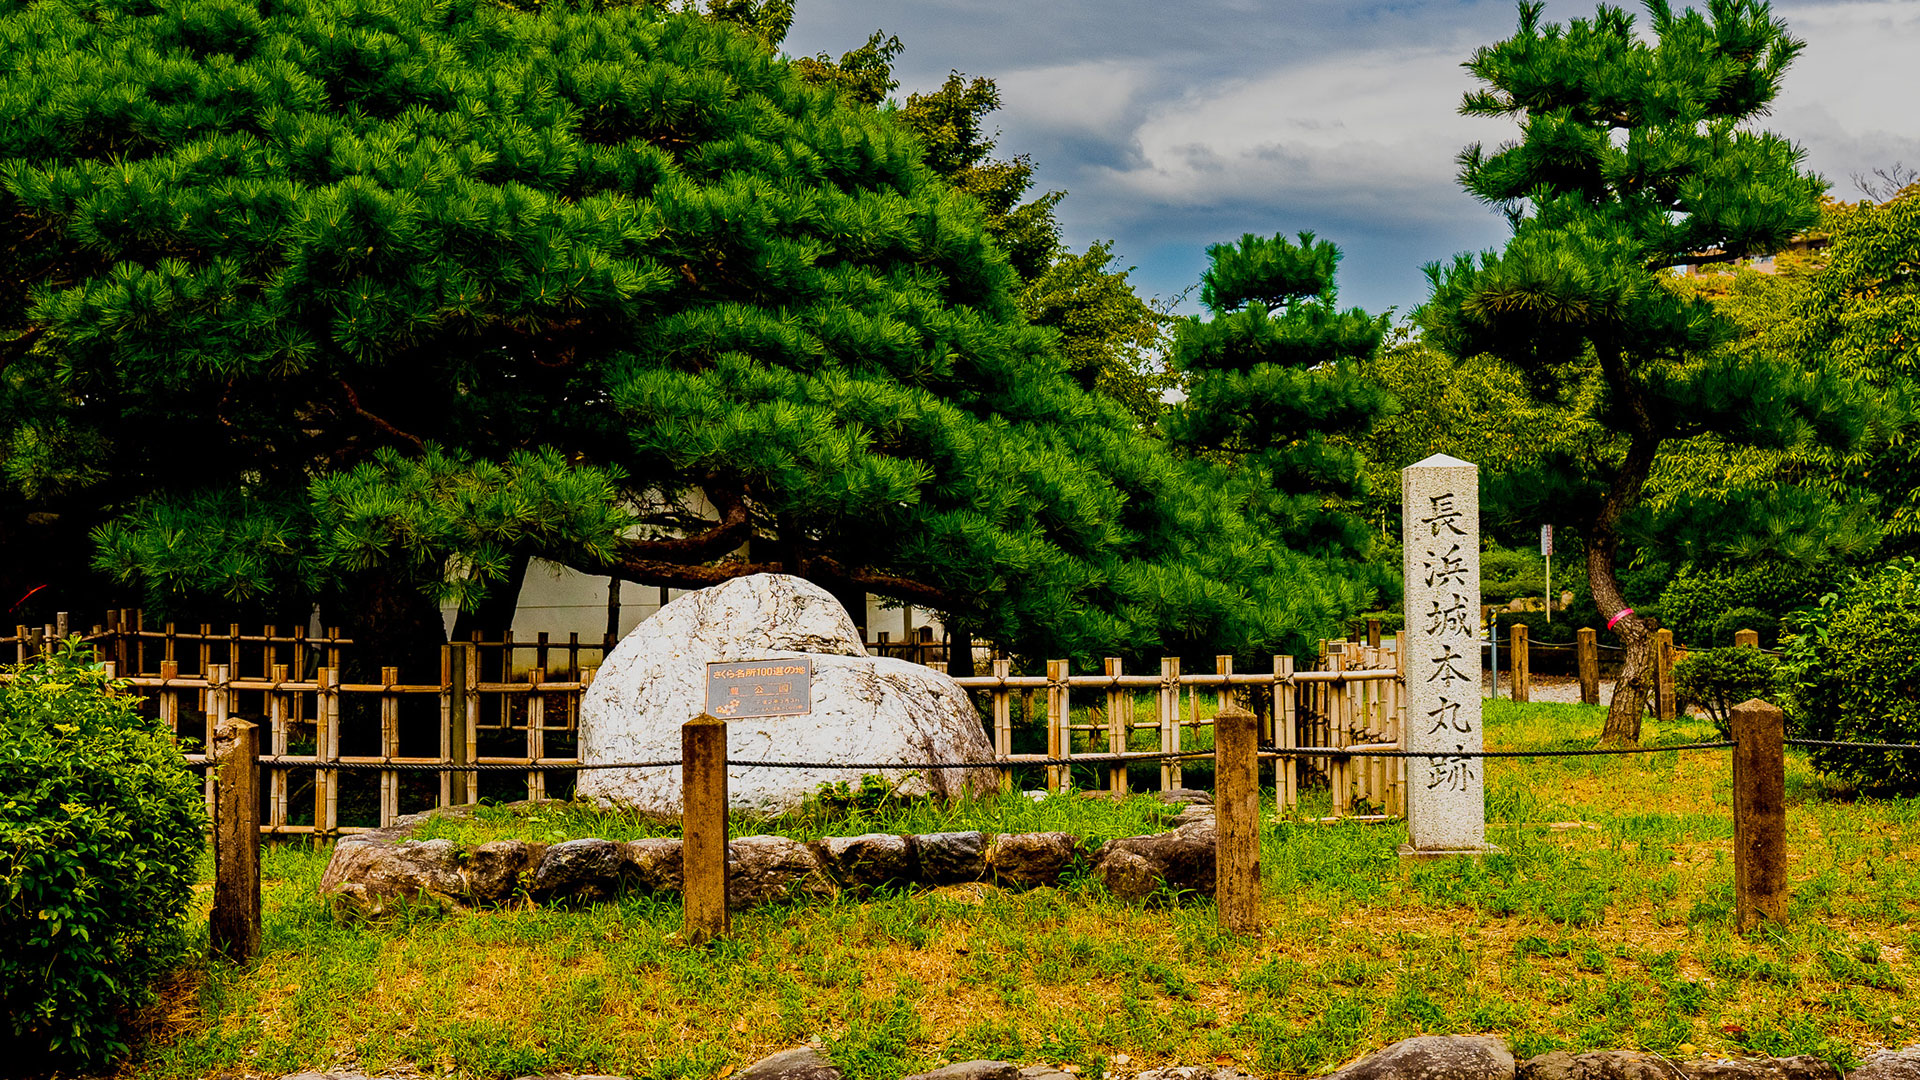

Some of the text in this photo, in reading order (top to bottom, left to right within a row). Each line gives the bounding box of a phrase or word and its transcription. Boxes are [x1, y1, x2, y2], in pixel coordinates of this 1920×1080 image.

[713, 666, 806, 679] さくら名所100選の地
[1421, 492, 1475, 792] 長浜城本丸跡
